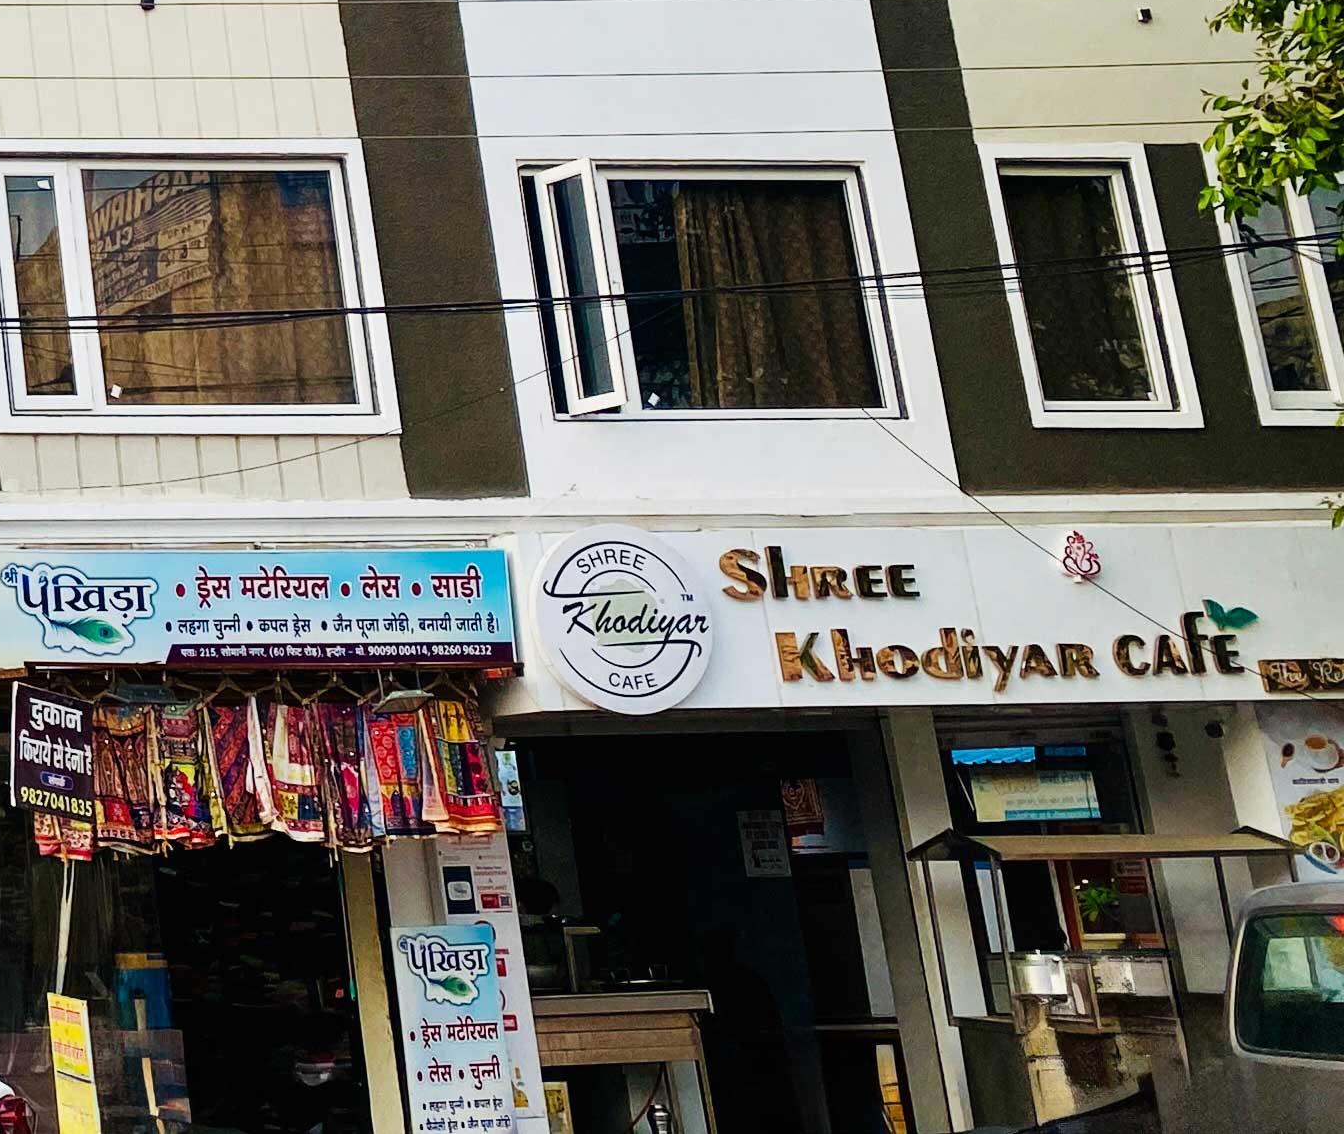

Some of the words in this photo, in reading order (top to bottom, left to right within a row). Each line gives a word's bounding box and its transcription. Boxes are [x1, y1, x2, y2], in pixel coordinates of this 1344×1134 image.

[4, 568, 18, 584] श्री
[576, 548, 647, 575] SHREE
[195, 565, 231, 608] ड्रेस
[239, 565, 329, 599] मटेरियल
[360, 565, 401, 599] लेस
[431, 563, 482, 603] साड़ी
[213, 613, 241, 640] चुन्नी
[258, 618, 288, 633] कपल
[292, 613, 311, 637] ड्रेस
[333, 613, 352, 632] जैन
[356, 618, 379, 639] पूजा
[418, 612, 451, 632] बनायी
[455, 611, 482, 632] जाती
[562, 600, 709, 643] Khodiyar
[368, 645, 397, 656] 90090
[398, 645, 430, 657] 00414,
[432, 644, 461, 656] 98260
[463, 644, 492, 655] 96232
[608, 672, 658, 690] CAFE
[29, 697, 83, 733] दुकान
[19, 729, 51, 767] किराये
[53, 737, 64, 769] से
[65, 739, 84, 774] देना
[20, 786, 93, 817] 9827041835
[421, 1017, 442, 1049] ड्रेस
[446, 1016, 500, 1041] मटेरियल
[428, 1057, 452, 1083] लेस
[469, 1054, 500, 1090] चुन्नी
